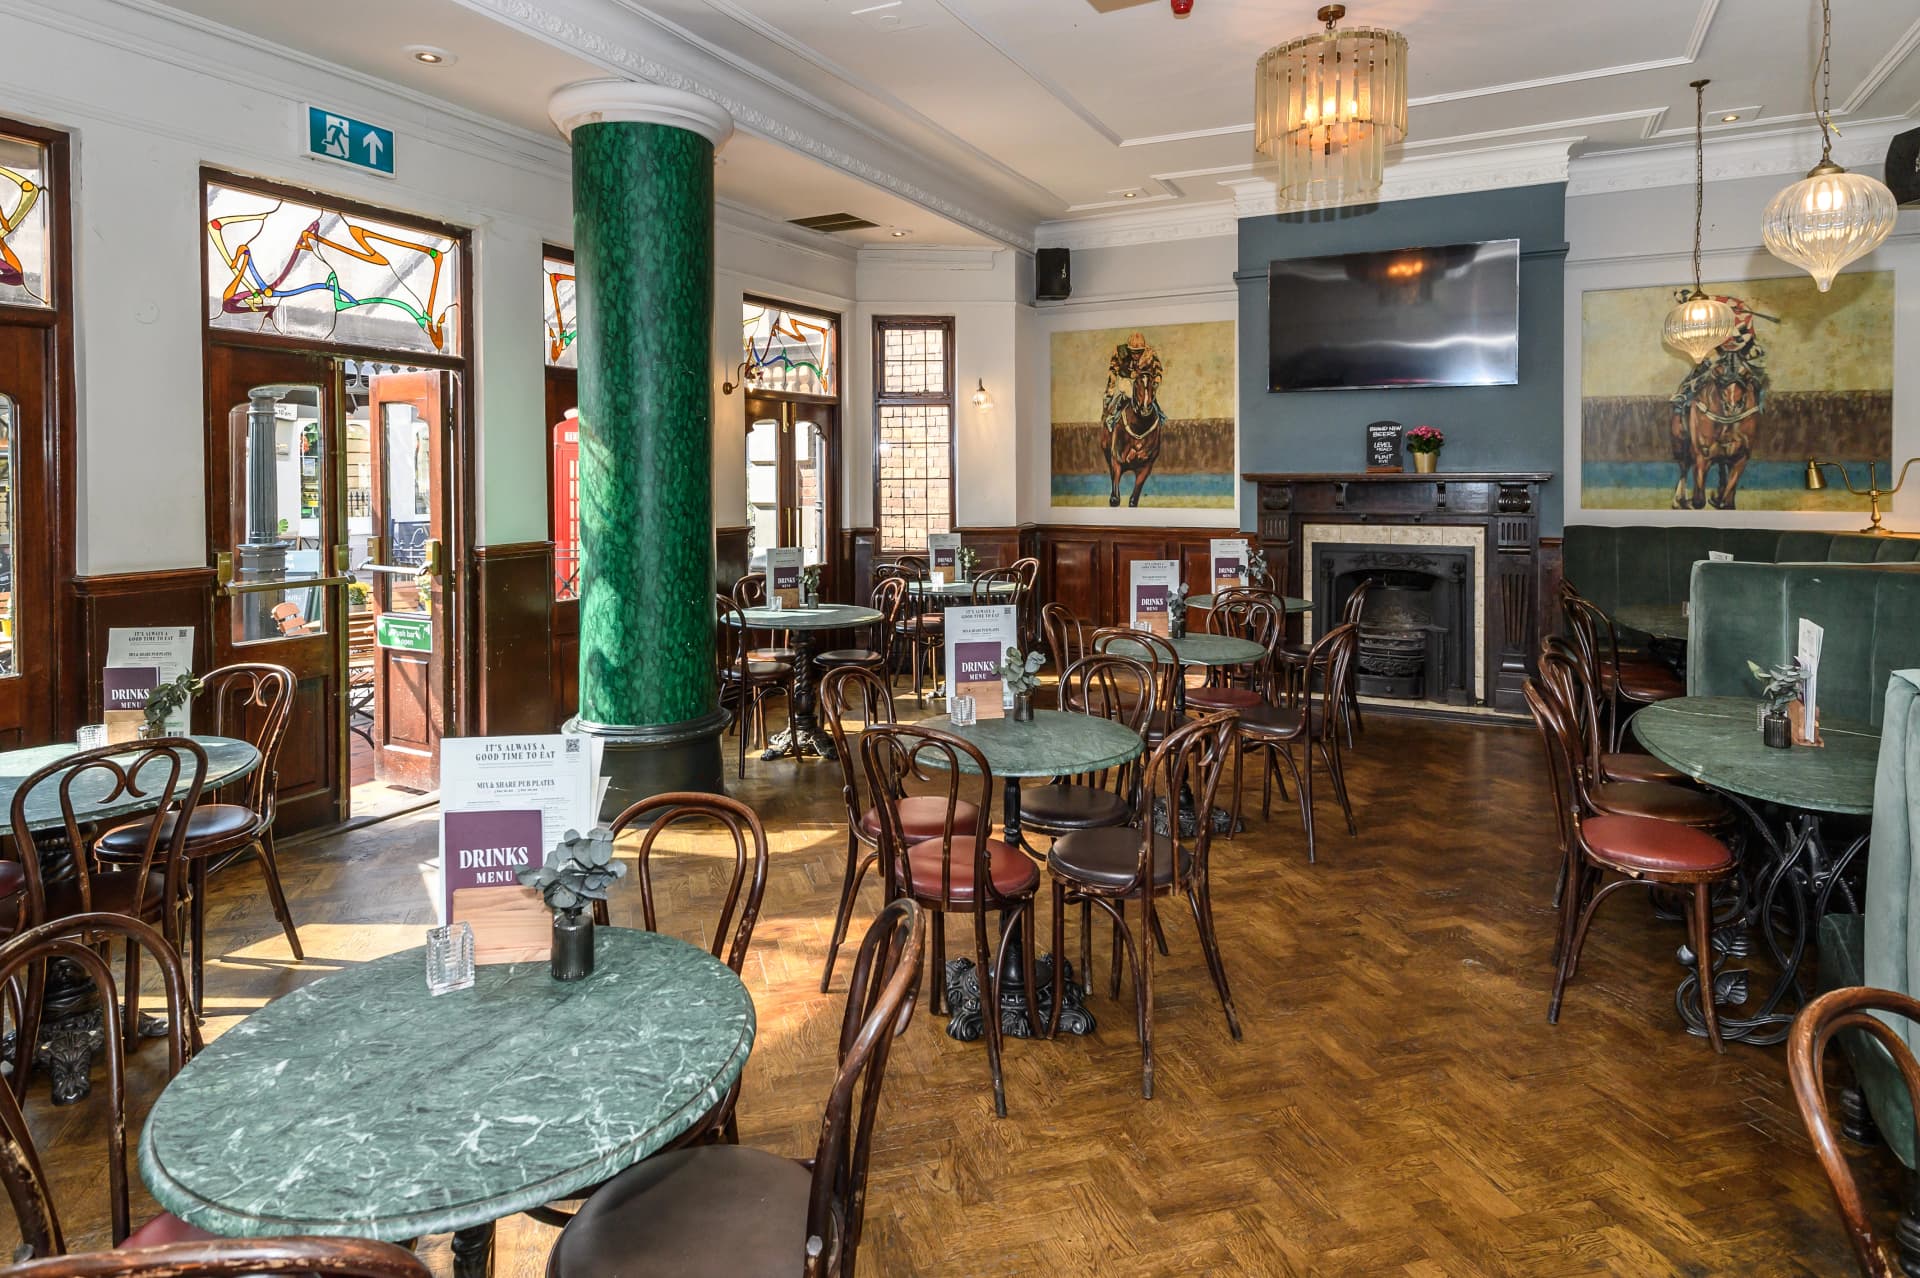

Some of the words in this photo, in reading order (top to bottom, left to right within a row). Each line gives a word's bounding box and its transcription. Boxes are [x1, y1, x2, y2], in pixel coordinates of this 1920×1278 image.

[961, 661, 994, 672] DRINKS
[111, 688, 150, 700] DRINKS
[485, 744, 502, 752] IT'S
[506, 743, 537, 751] ALWAYS
[476, 753, 499, 761] GOOD
[502, 752, 524, 760] TIME
[540, 751, 556, 759] EAT
[532, 779, 555, 787] PLATES
[459, 846, 529, 869] DRINKS
[476, 870, 513, 884] MENU
